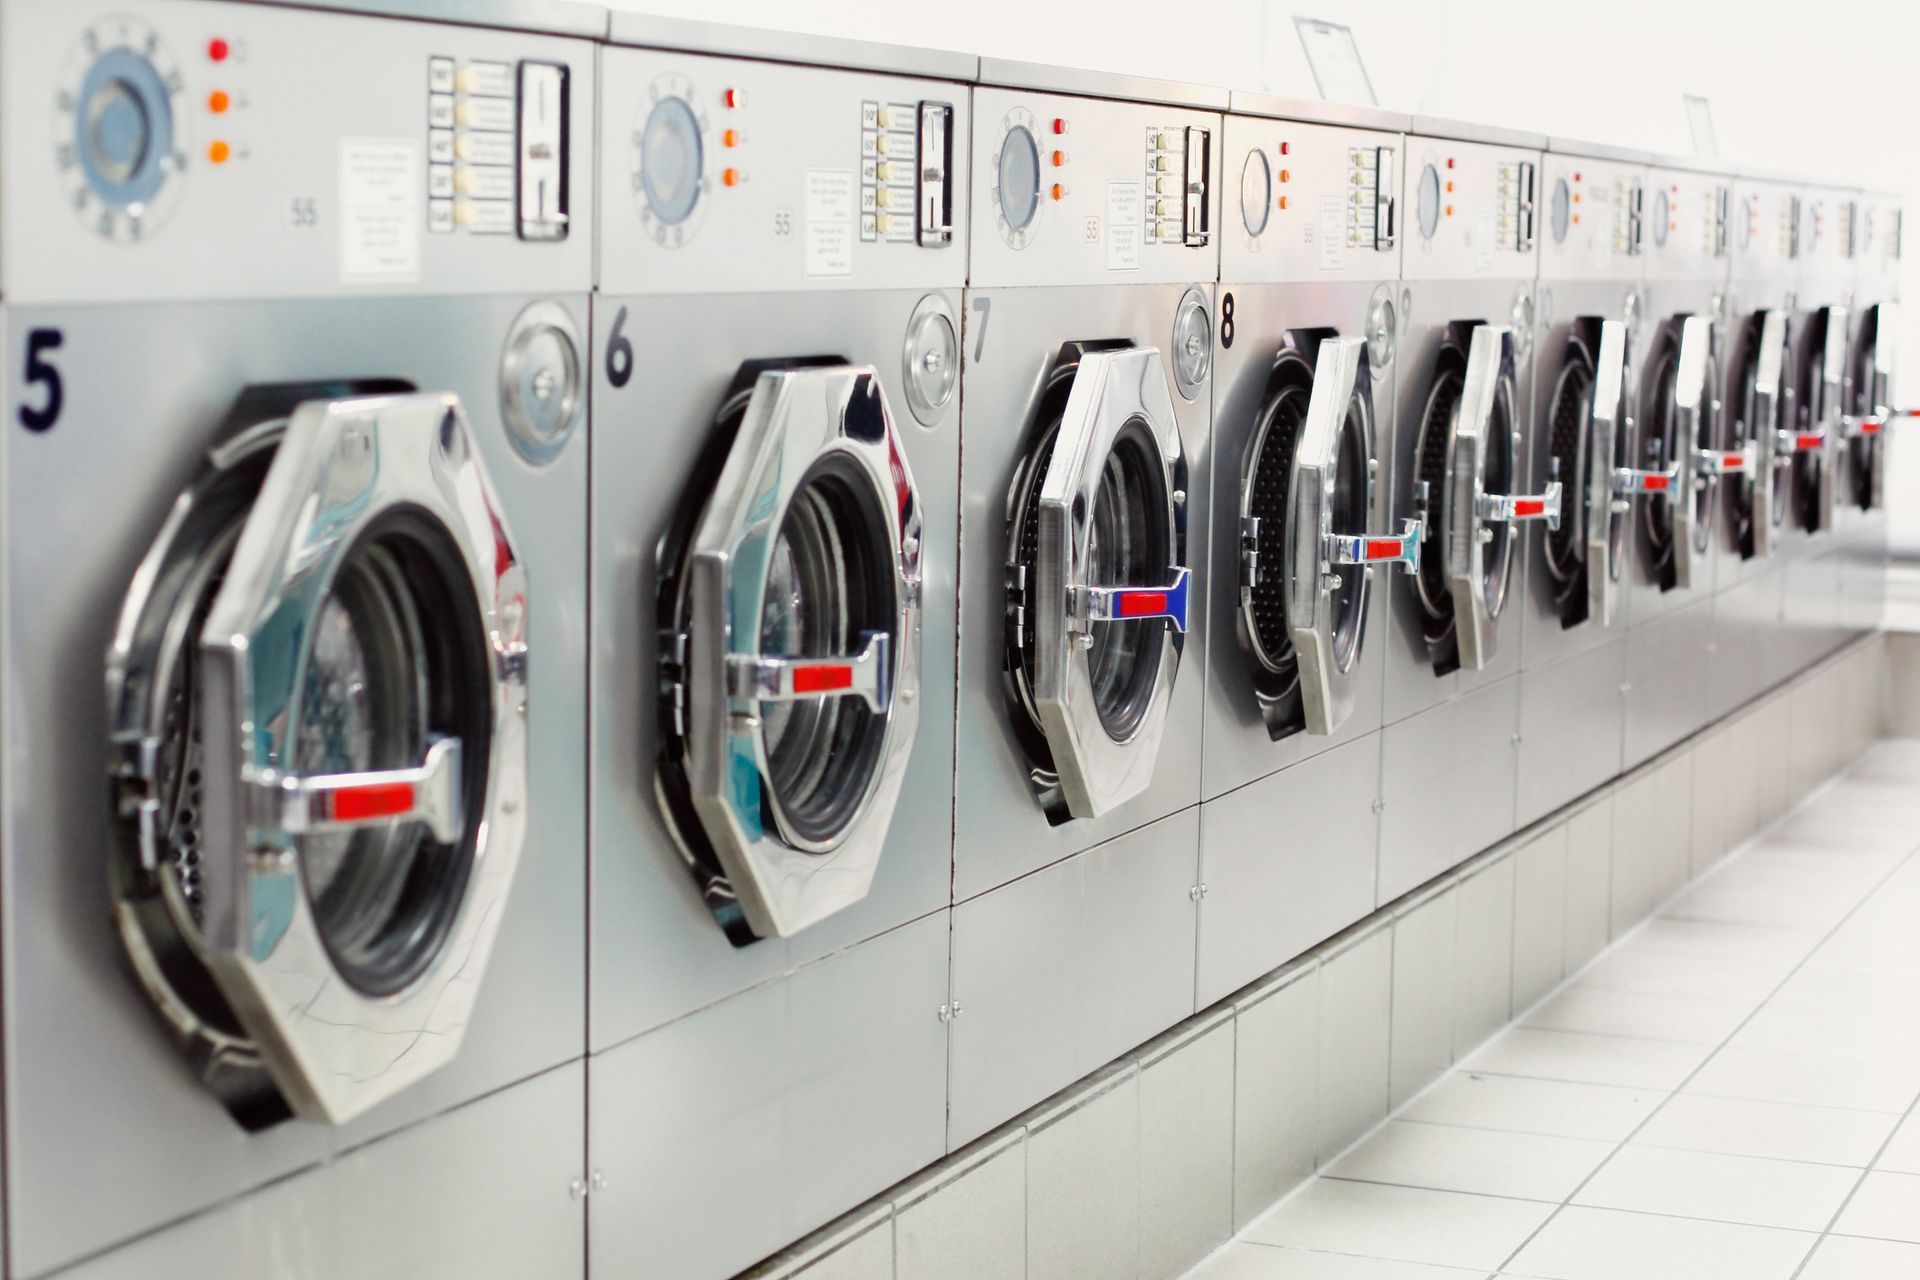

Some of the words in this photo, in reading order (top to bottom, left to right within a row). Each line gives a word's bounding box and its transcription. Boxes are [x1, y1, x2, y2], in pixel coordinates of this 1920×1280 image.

[775, 213, 791, 236] 55
[1086, 220, 1098, 239] 55
[605, 304, 633, 389] 6
[972, 297, 991, 364] 7
[1220, 292, 1235, 350] 8
[18, 327, 63, 434] 5
